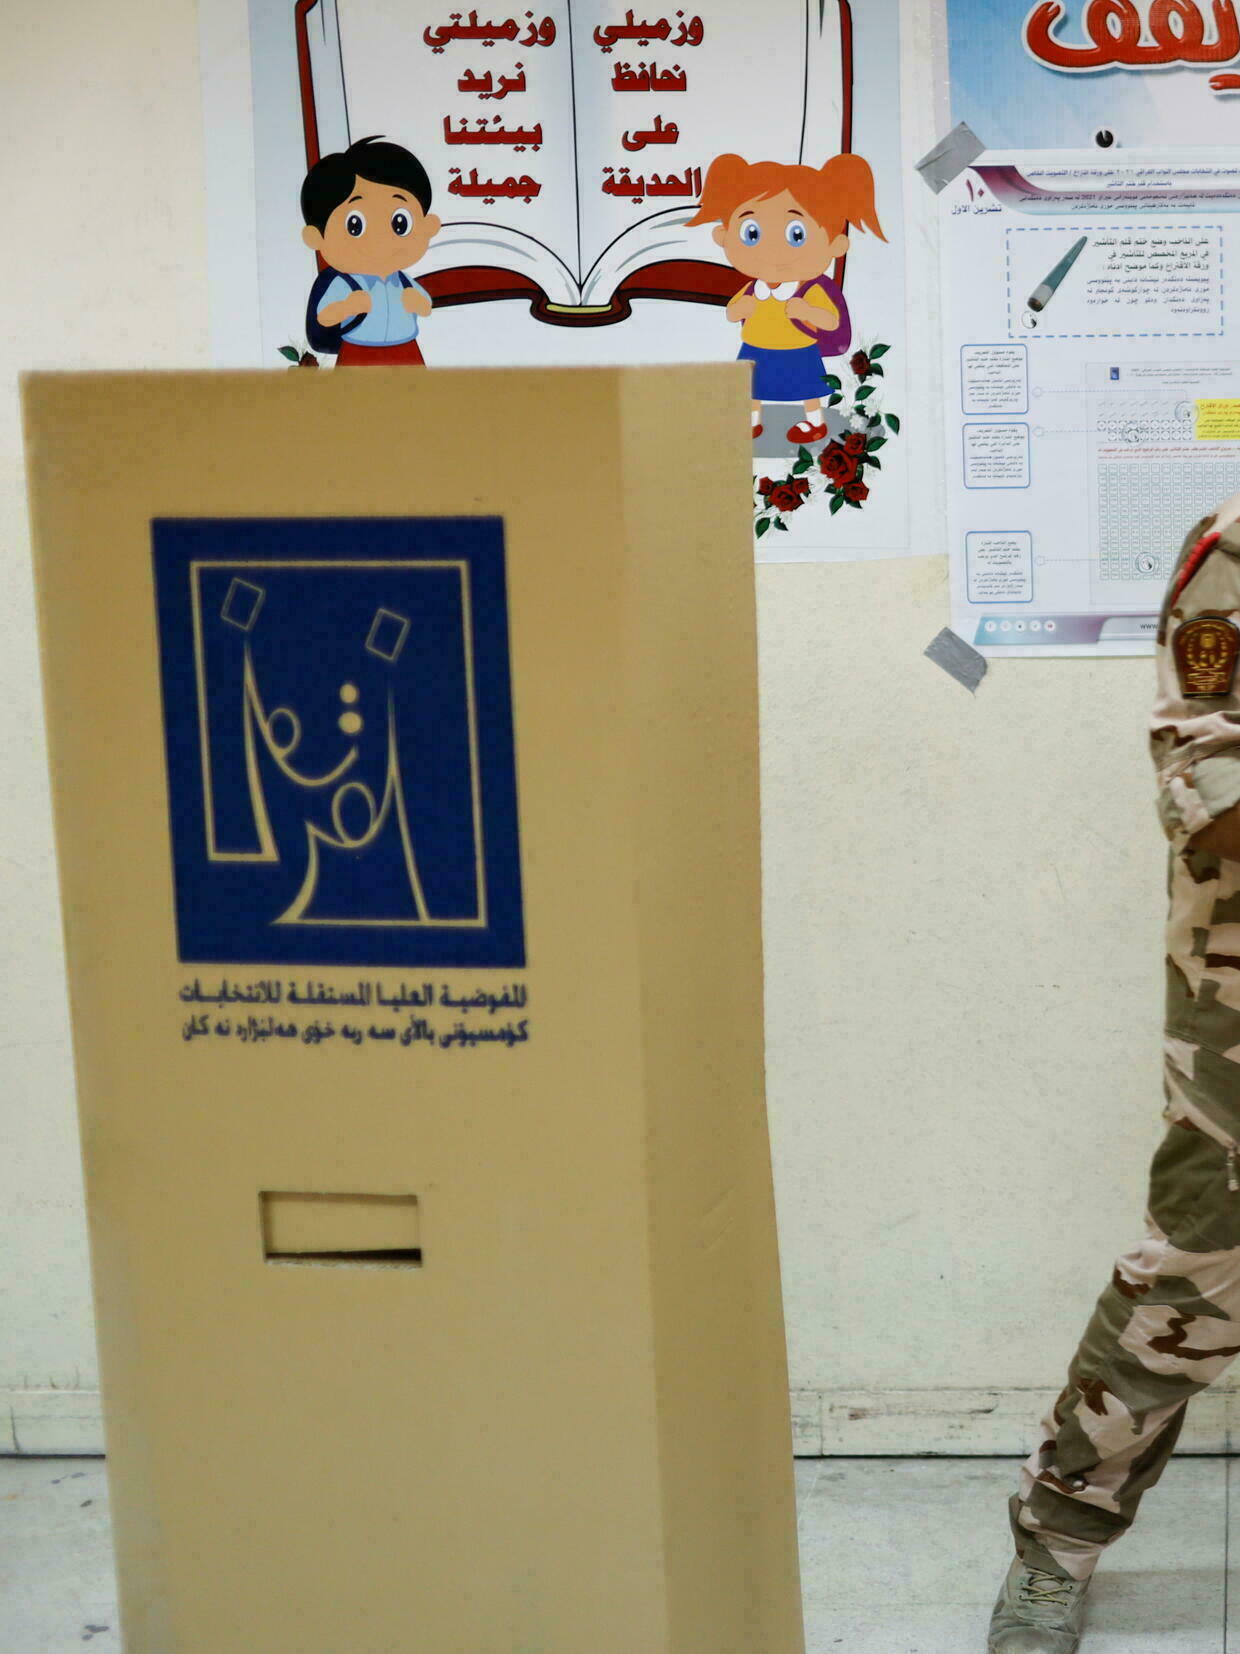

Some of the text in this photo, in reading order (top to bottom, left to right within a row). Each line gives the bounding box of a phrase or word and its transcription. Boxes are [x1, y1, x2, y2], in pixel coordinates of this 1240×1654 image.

[422, 8, 557, 54] وزميلتي
[592, 8, 705, 54] وزميلي
[456, 61, 527, 100] نريد
[610, 60, 687, 92] نحافظ
[442, 114, 544, 152] بيئتنا
[620, 114, 680, 152] على
[446, 167, 543, 205] جميلة
[600, 165, 702, 204] الحديقة
[375, 981, 434, 1014] العليا
